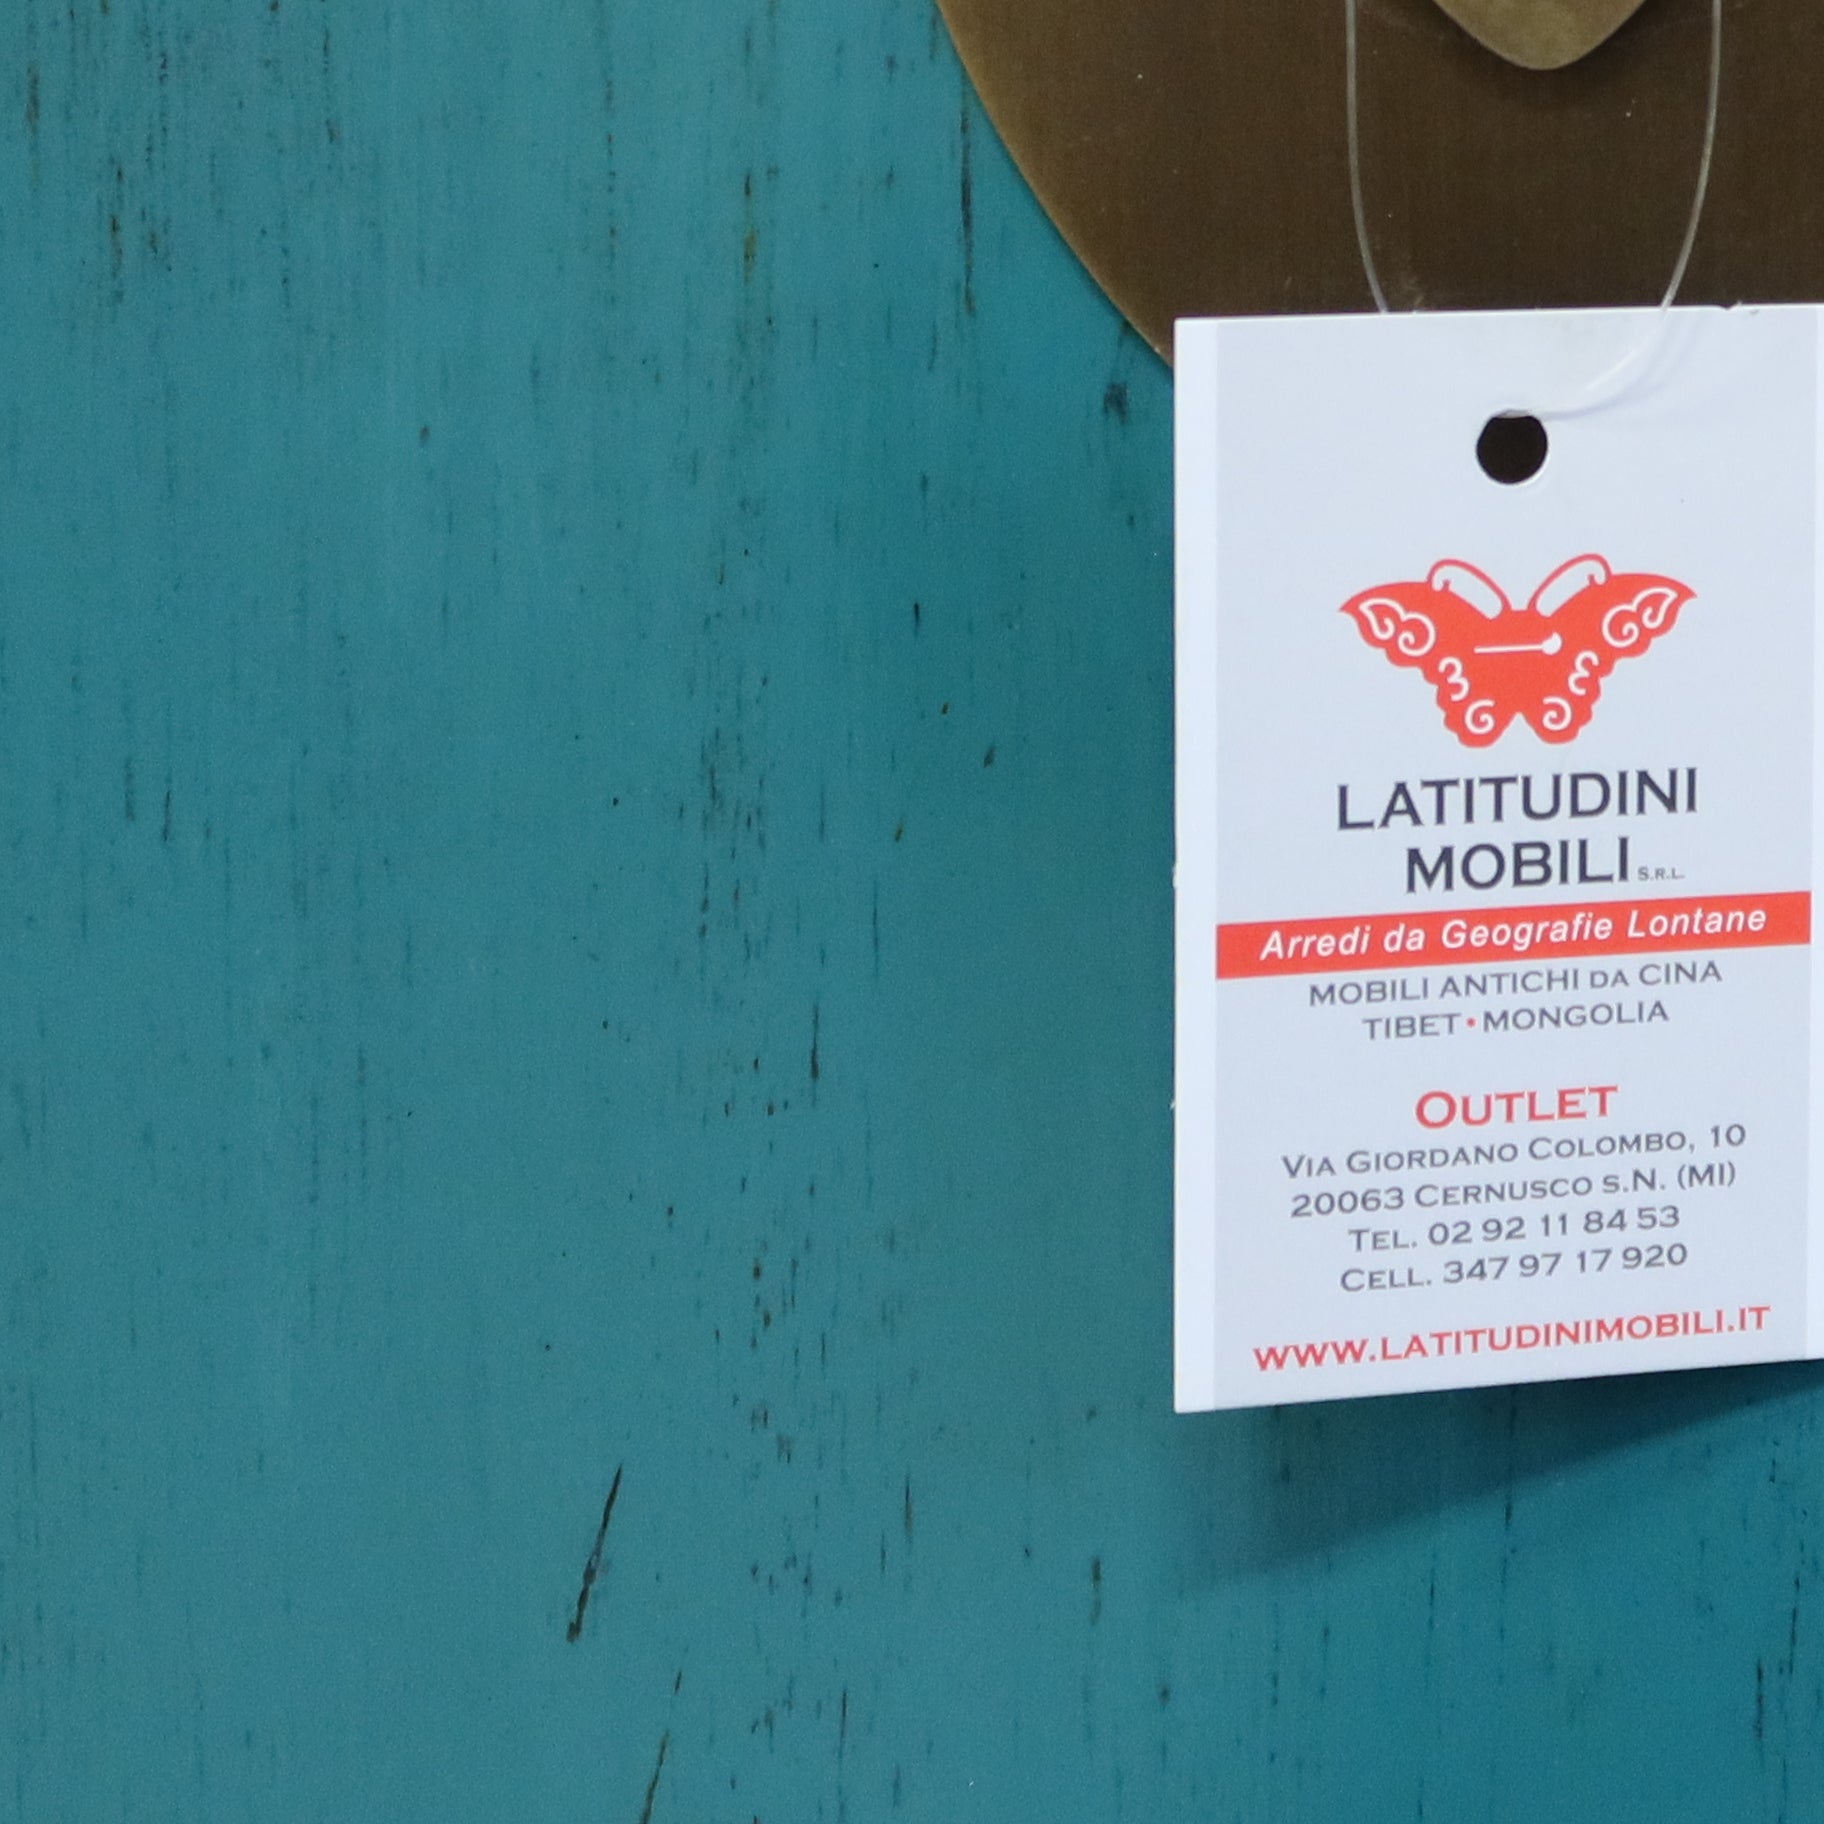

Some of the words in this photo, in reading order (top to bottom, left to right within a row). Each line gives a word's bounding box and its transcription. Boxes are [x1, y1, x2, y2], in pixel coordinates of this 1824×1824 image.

[1337, 767, 1698, 831] LATITUDINI
[1406, 836, 1629, 894] MOBILI
[1259, 925, 1371, 961] Arredi
[1383, 922, 1426, 953] da
[1441, 911, 1613, 952] Geografie
[1627, 907, 1767, 938] Lontane
[1309, 977, 1429, 1007] MOBILI
[1439, 968, 1579, 998] ANTICHI
[1638, 960, 1722, 986] CINA
[1711, 1123, 1746, 1148] 10
[1291, 1186, 1405, 1218] 20063
[1677, 1161, 1736, 1190] (MI)
[1428, 1220, 1473, 1246] 02
[1481, 1216, 1526, 1242] 92
[1541, 1213, 1567, 1237] 11
[1583, 1208, 1627, 1234] 84
[1637, 1205, 1680, 1230] 53
[1443, 1256, 1509, 1284] 347
[1518, 1252, 1562, 1278] 97
[1577, 1248, 1612, 1273] 17
[1622, 1242, 1688, 1270] 920
[1253, 1306, 1771, 1372] WWW.LATITUDINIMOBILI.IT
